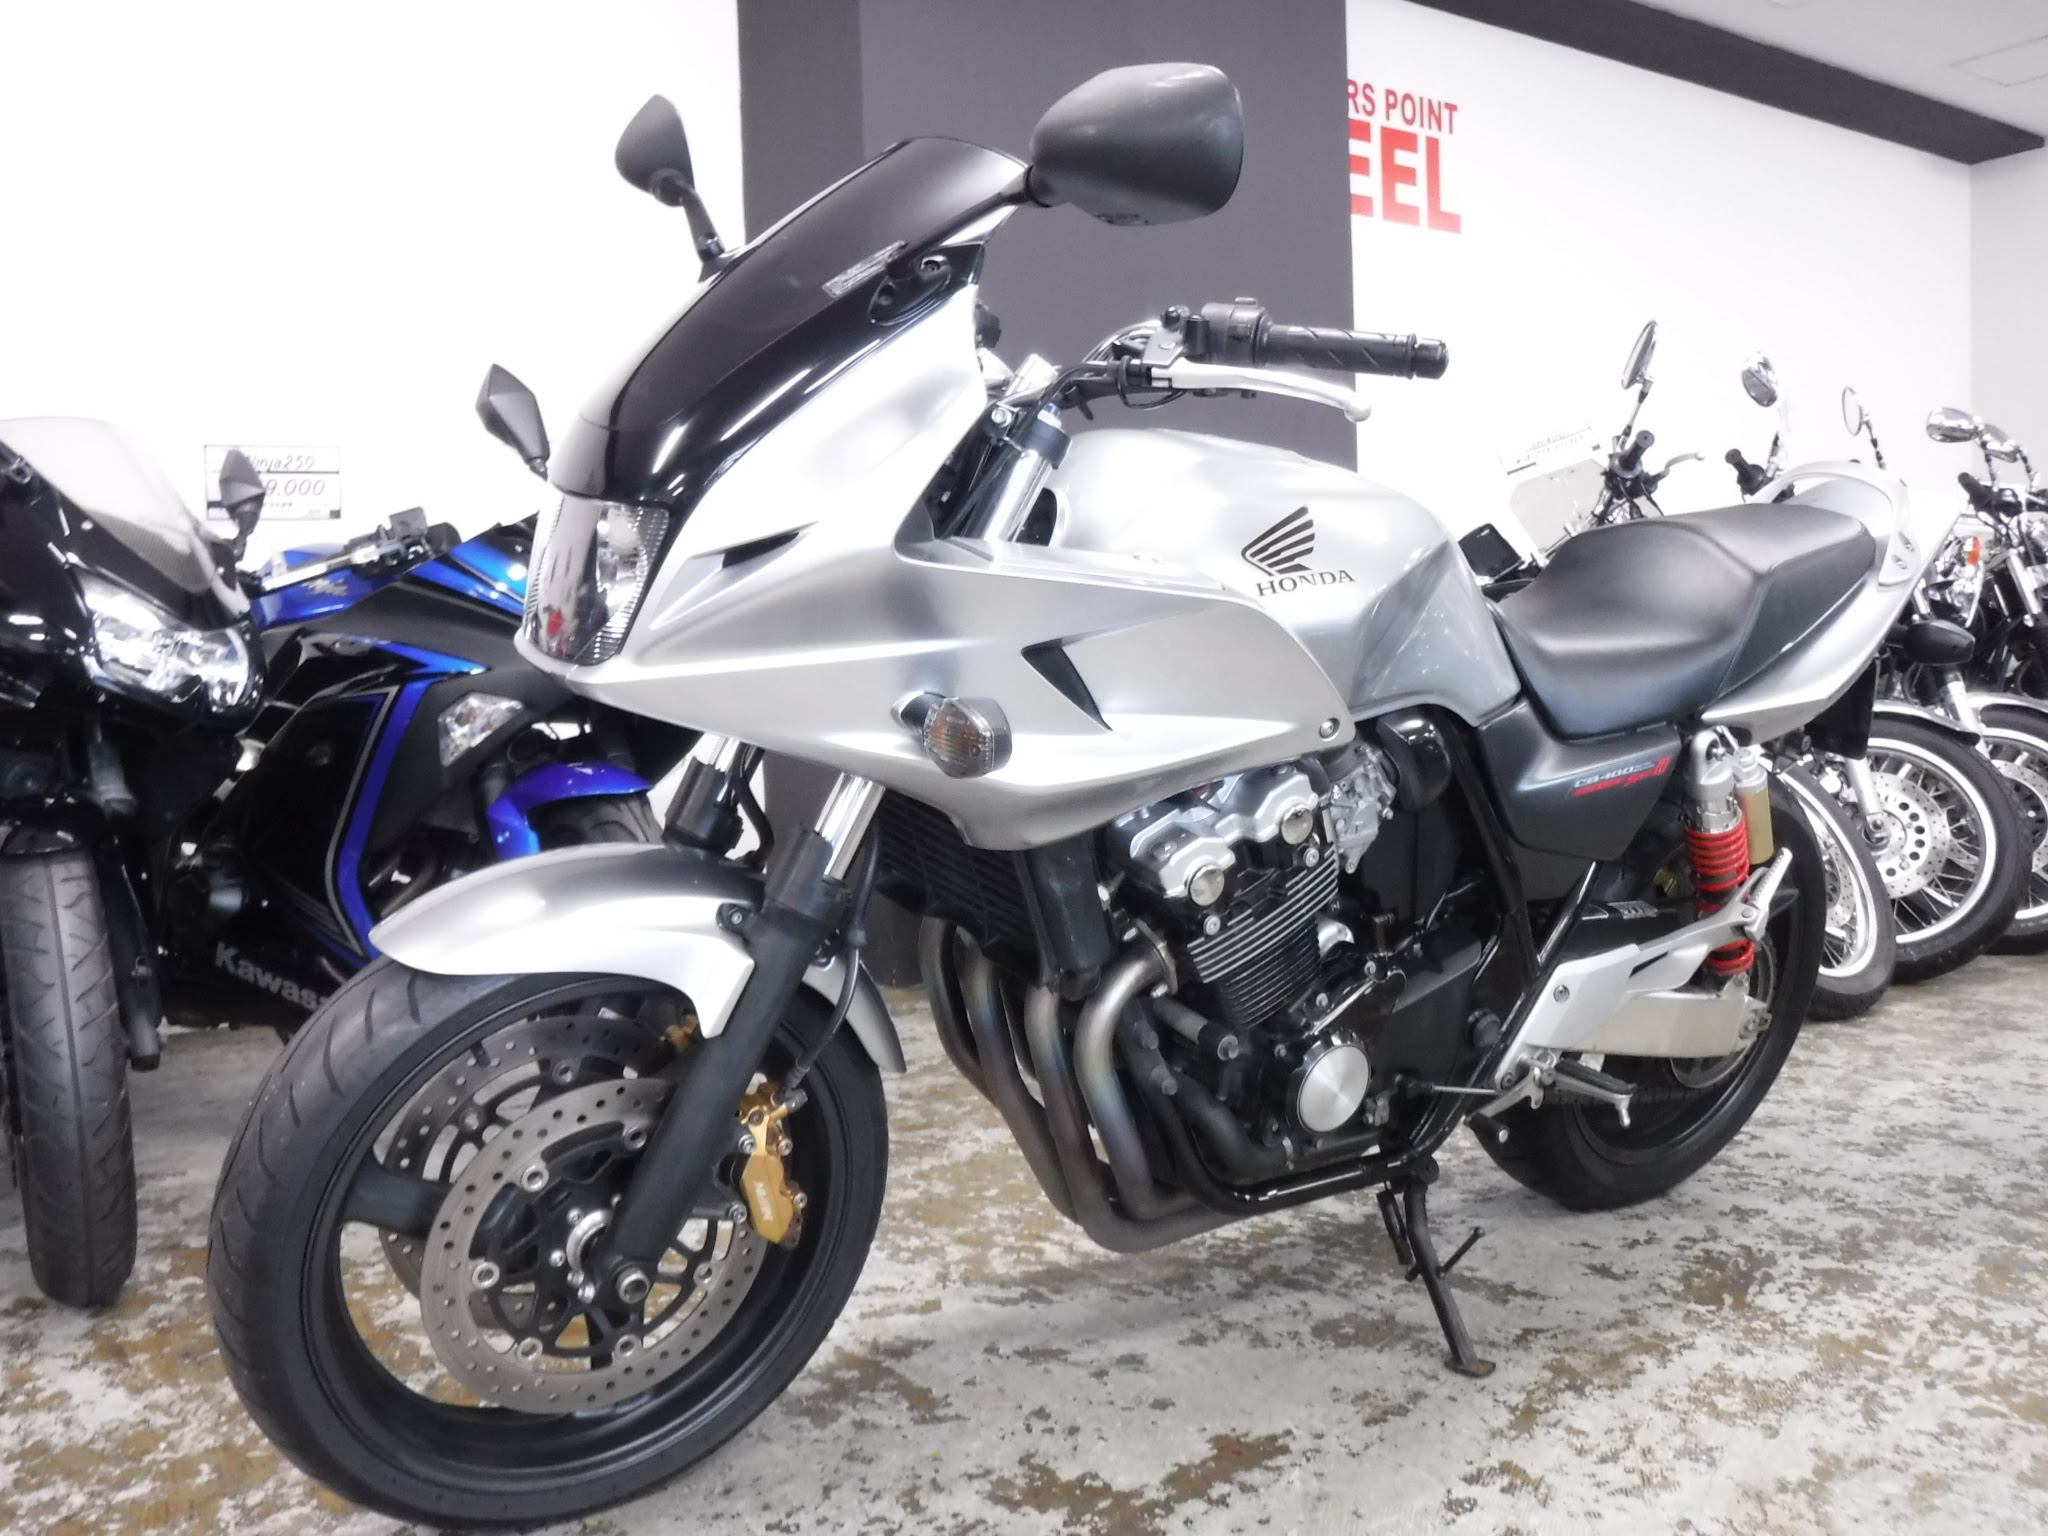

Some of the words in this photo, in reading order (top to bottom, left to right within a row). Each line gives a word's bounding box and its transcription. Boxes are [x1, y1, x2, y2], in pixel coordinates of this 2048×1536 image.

[1385, 88, 1458, 135] POINT
[1348, 118, 1461, 234] EEL
[1256, 569, 1356, 597] HONDA
[216, 941, 329, 1011] Kawas
